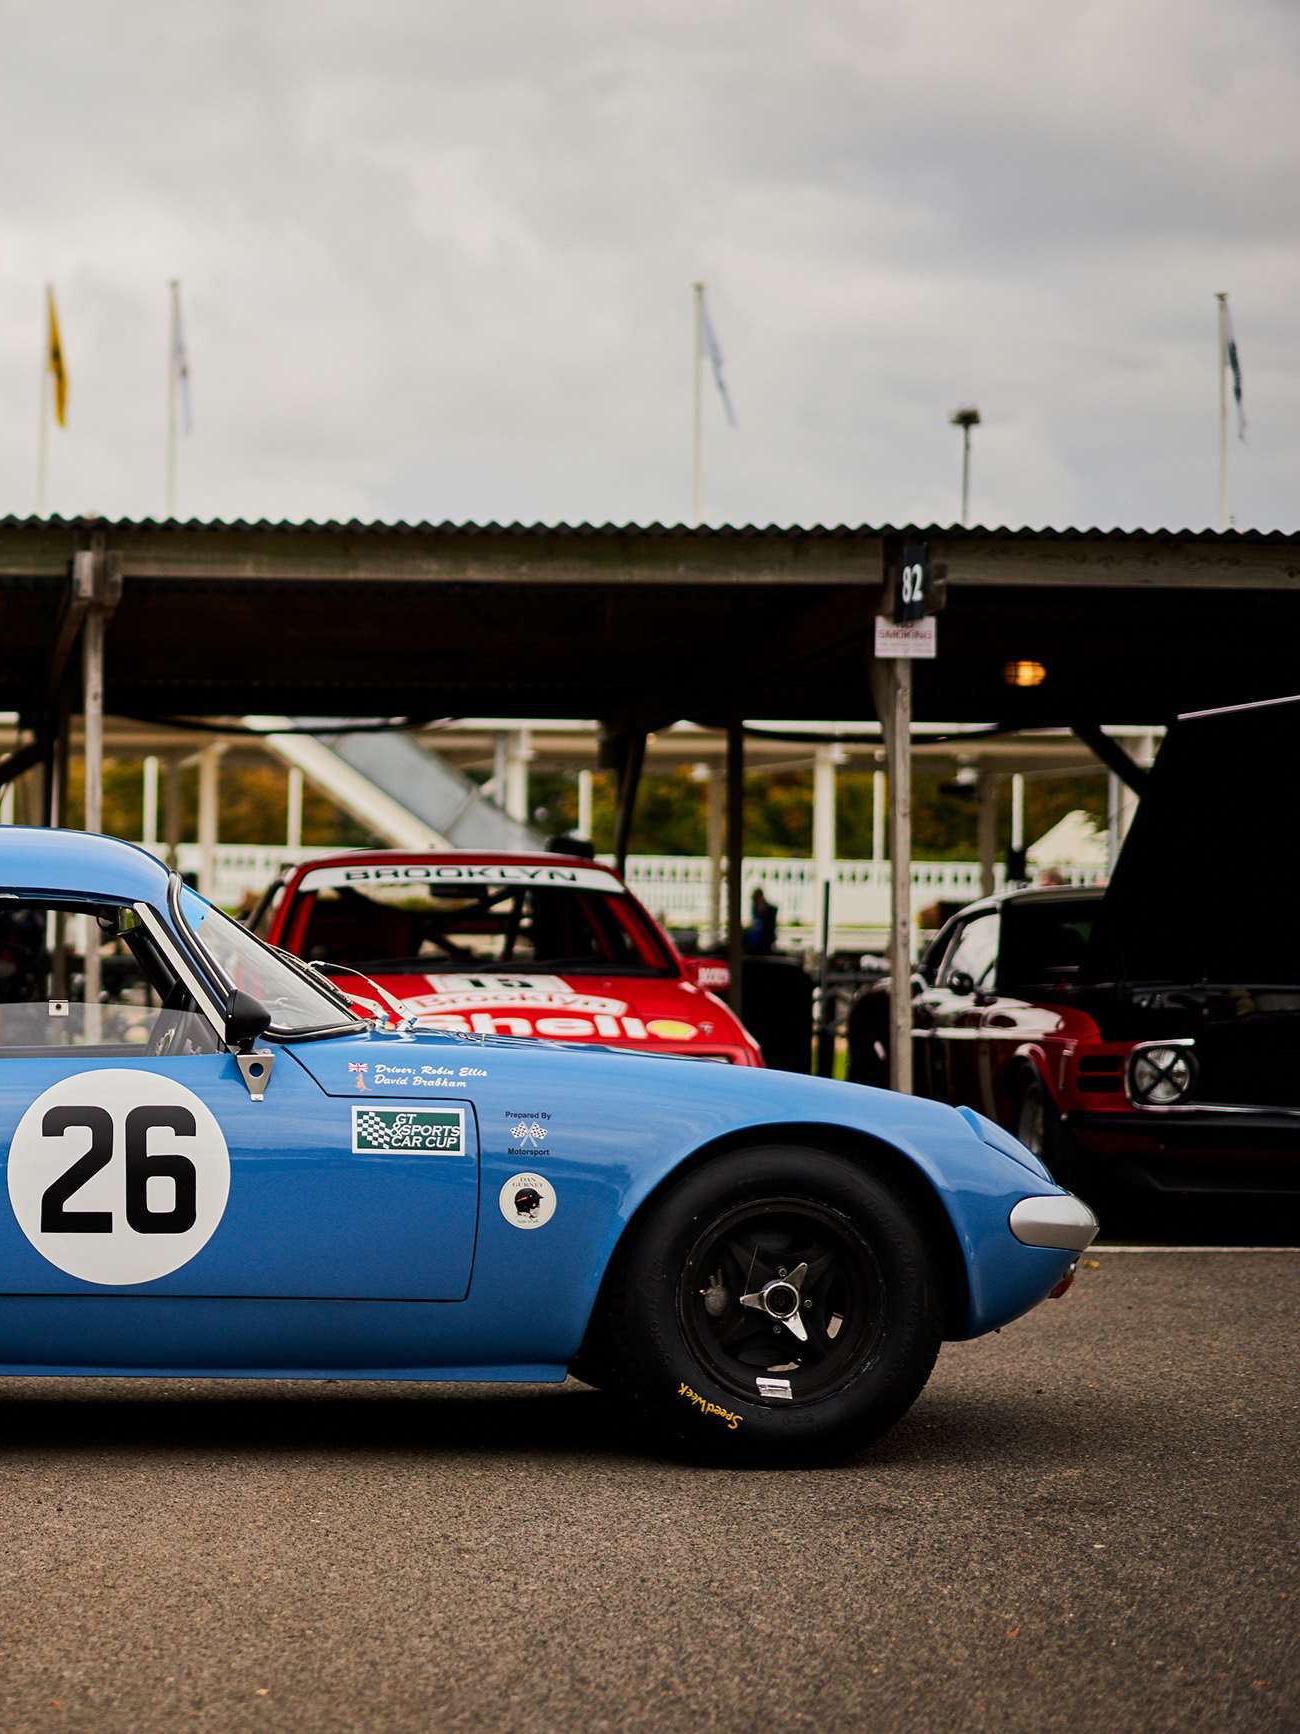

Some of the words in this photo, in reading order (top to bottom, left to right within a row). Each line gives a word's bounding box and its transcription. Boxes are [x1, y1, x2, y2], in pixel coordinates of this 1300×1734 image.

[902, 563, 923, 603] 82
[346, 867, 577, 882] BROOKLYN
[420, 1065, 454, 1076] Robin
[459, 1067, 488, 1077] Ellis
[373, 1074, 408, 1086] David
[412, 1076, 467, 1088] Brabham
[396, 1113, 417, 1125] GT
[505, 1111, 539, 1120] Prepared
[541, 1112, 552, 1121] By
[391, 1136, 422, 1147] CAR
[425, 1137, 457, 1148] CUP
[507, 1147, 550, 1157] Motorsport
[40, 1105, 197, 1235] 26
